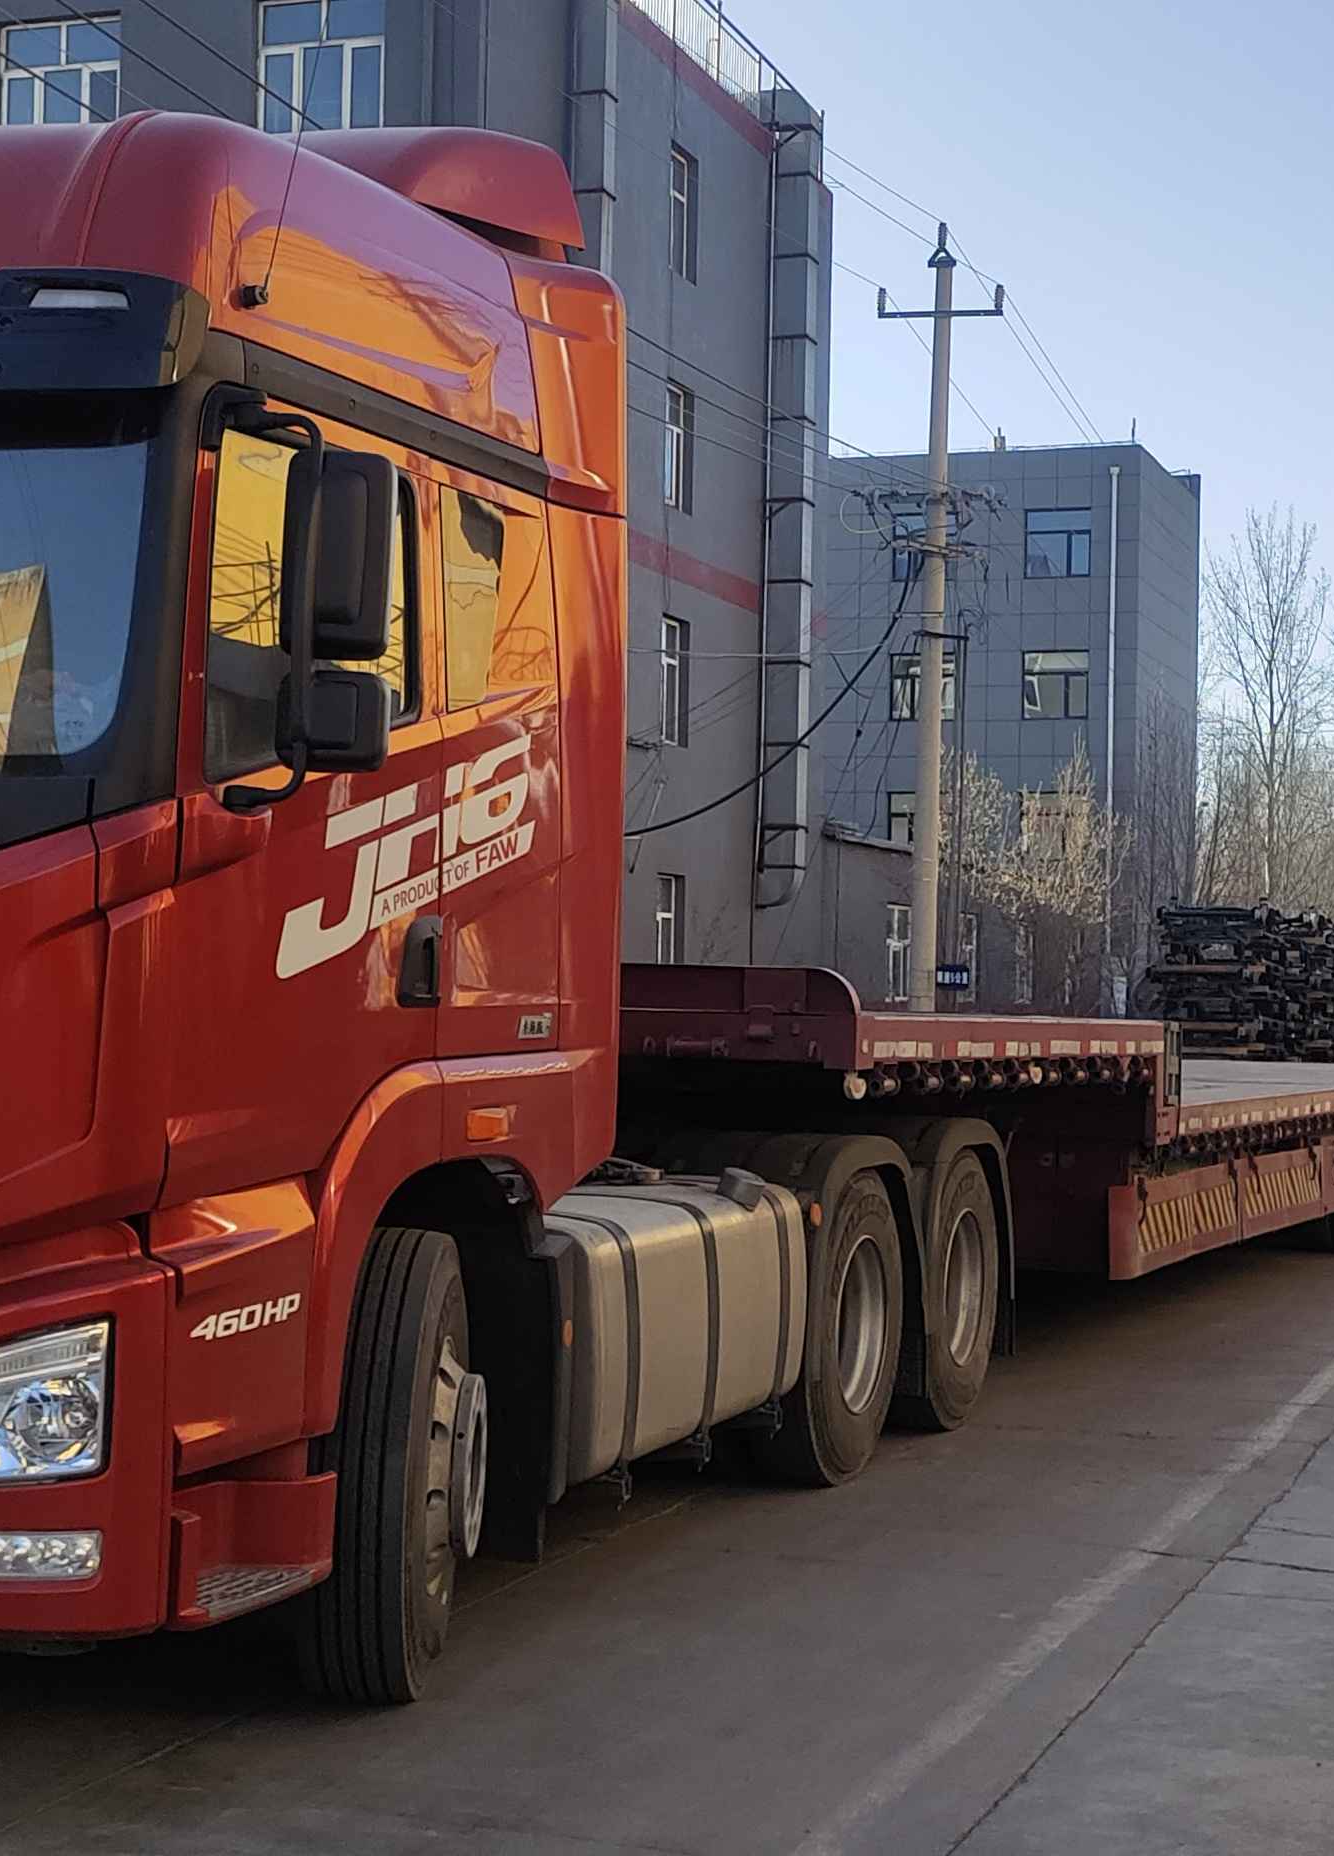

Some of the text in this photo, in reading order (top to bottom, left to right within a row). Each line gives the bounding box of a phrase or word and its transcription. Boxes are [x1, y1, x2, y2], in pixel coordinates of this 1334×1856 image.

[380, 835, 518, 917] A PRODUCT OF FAW
[189, 1292, 302, 1341] 460HP
